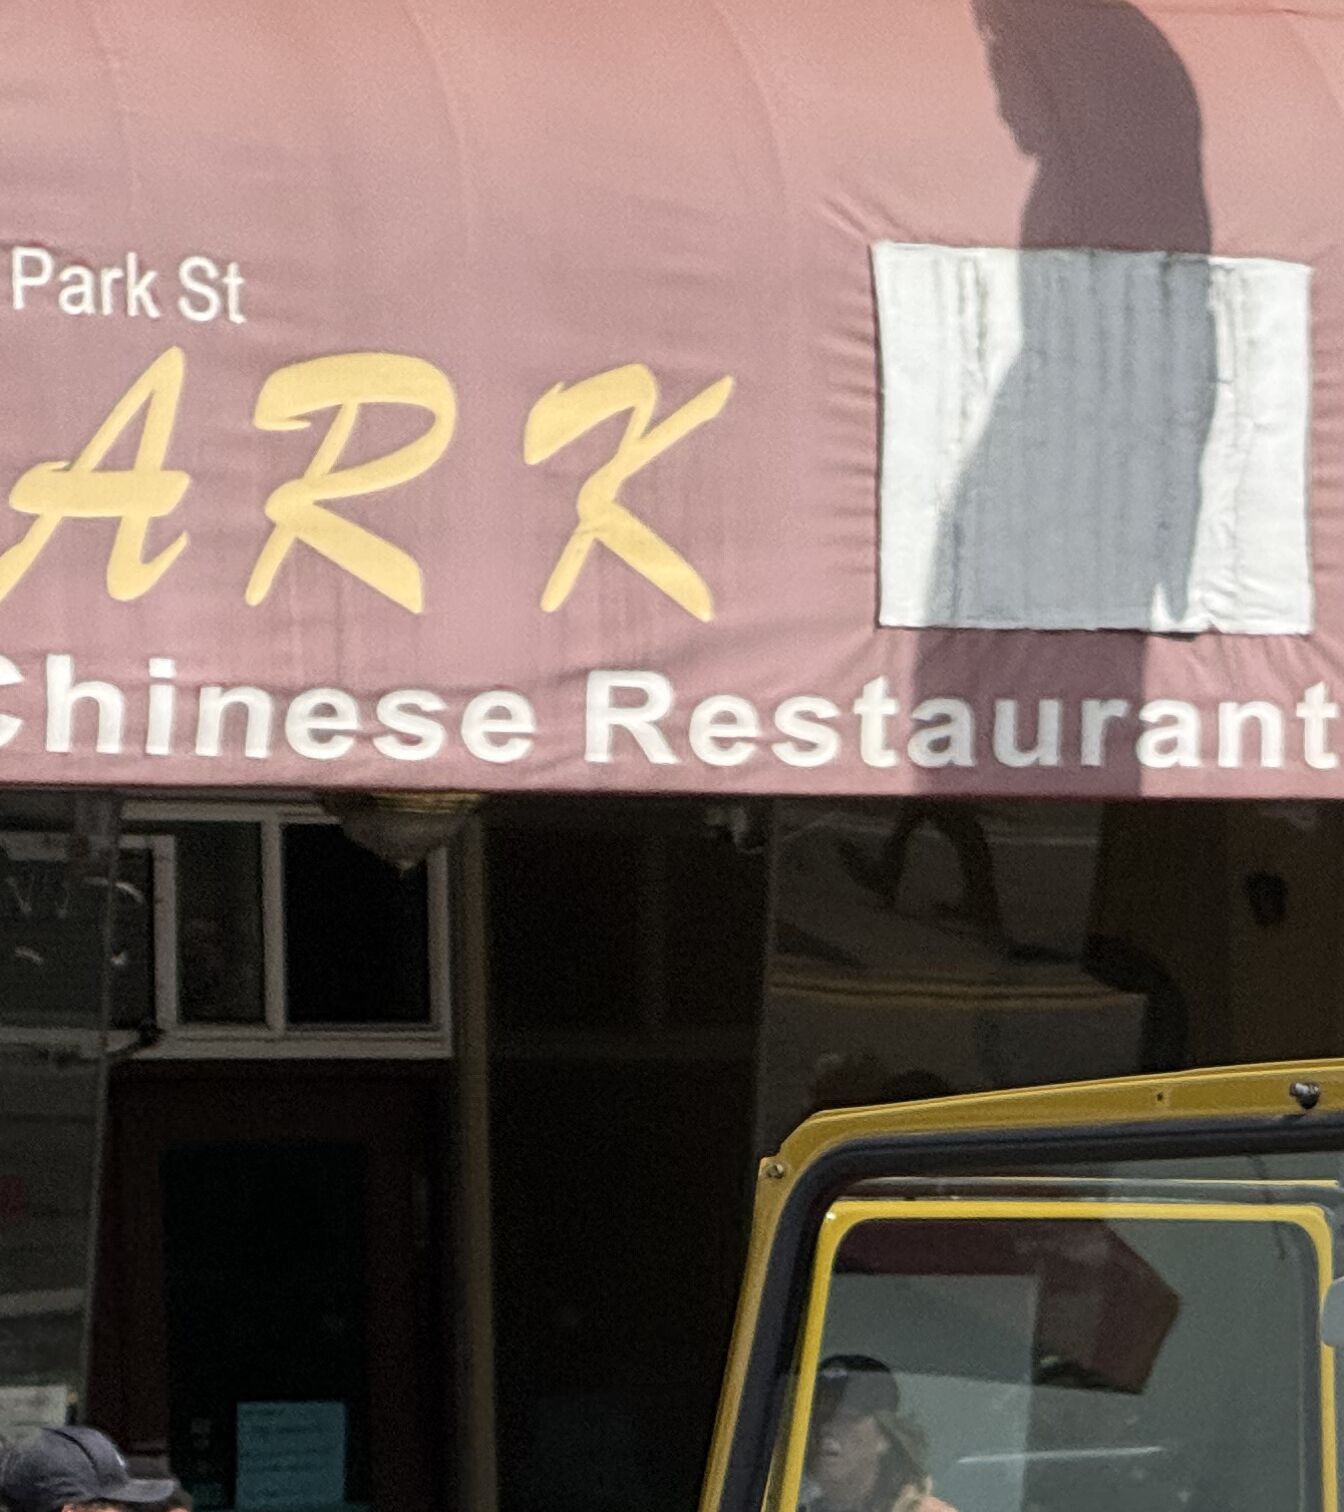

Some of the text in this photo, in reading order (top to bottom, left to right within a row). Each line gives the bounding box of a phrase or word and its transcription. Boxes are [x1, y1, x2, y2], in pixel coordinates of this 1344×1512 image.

[12, 246, 246, 325] Park St
[0, 345, 736, 625] ARK
[0, 652, 1343, 771] hinese Restaurant
